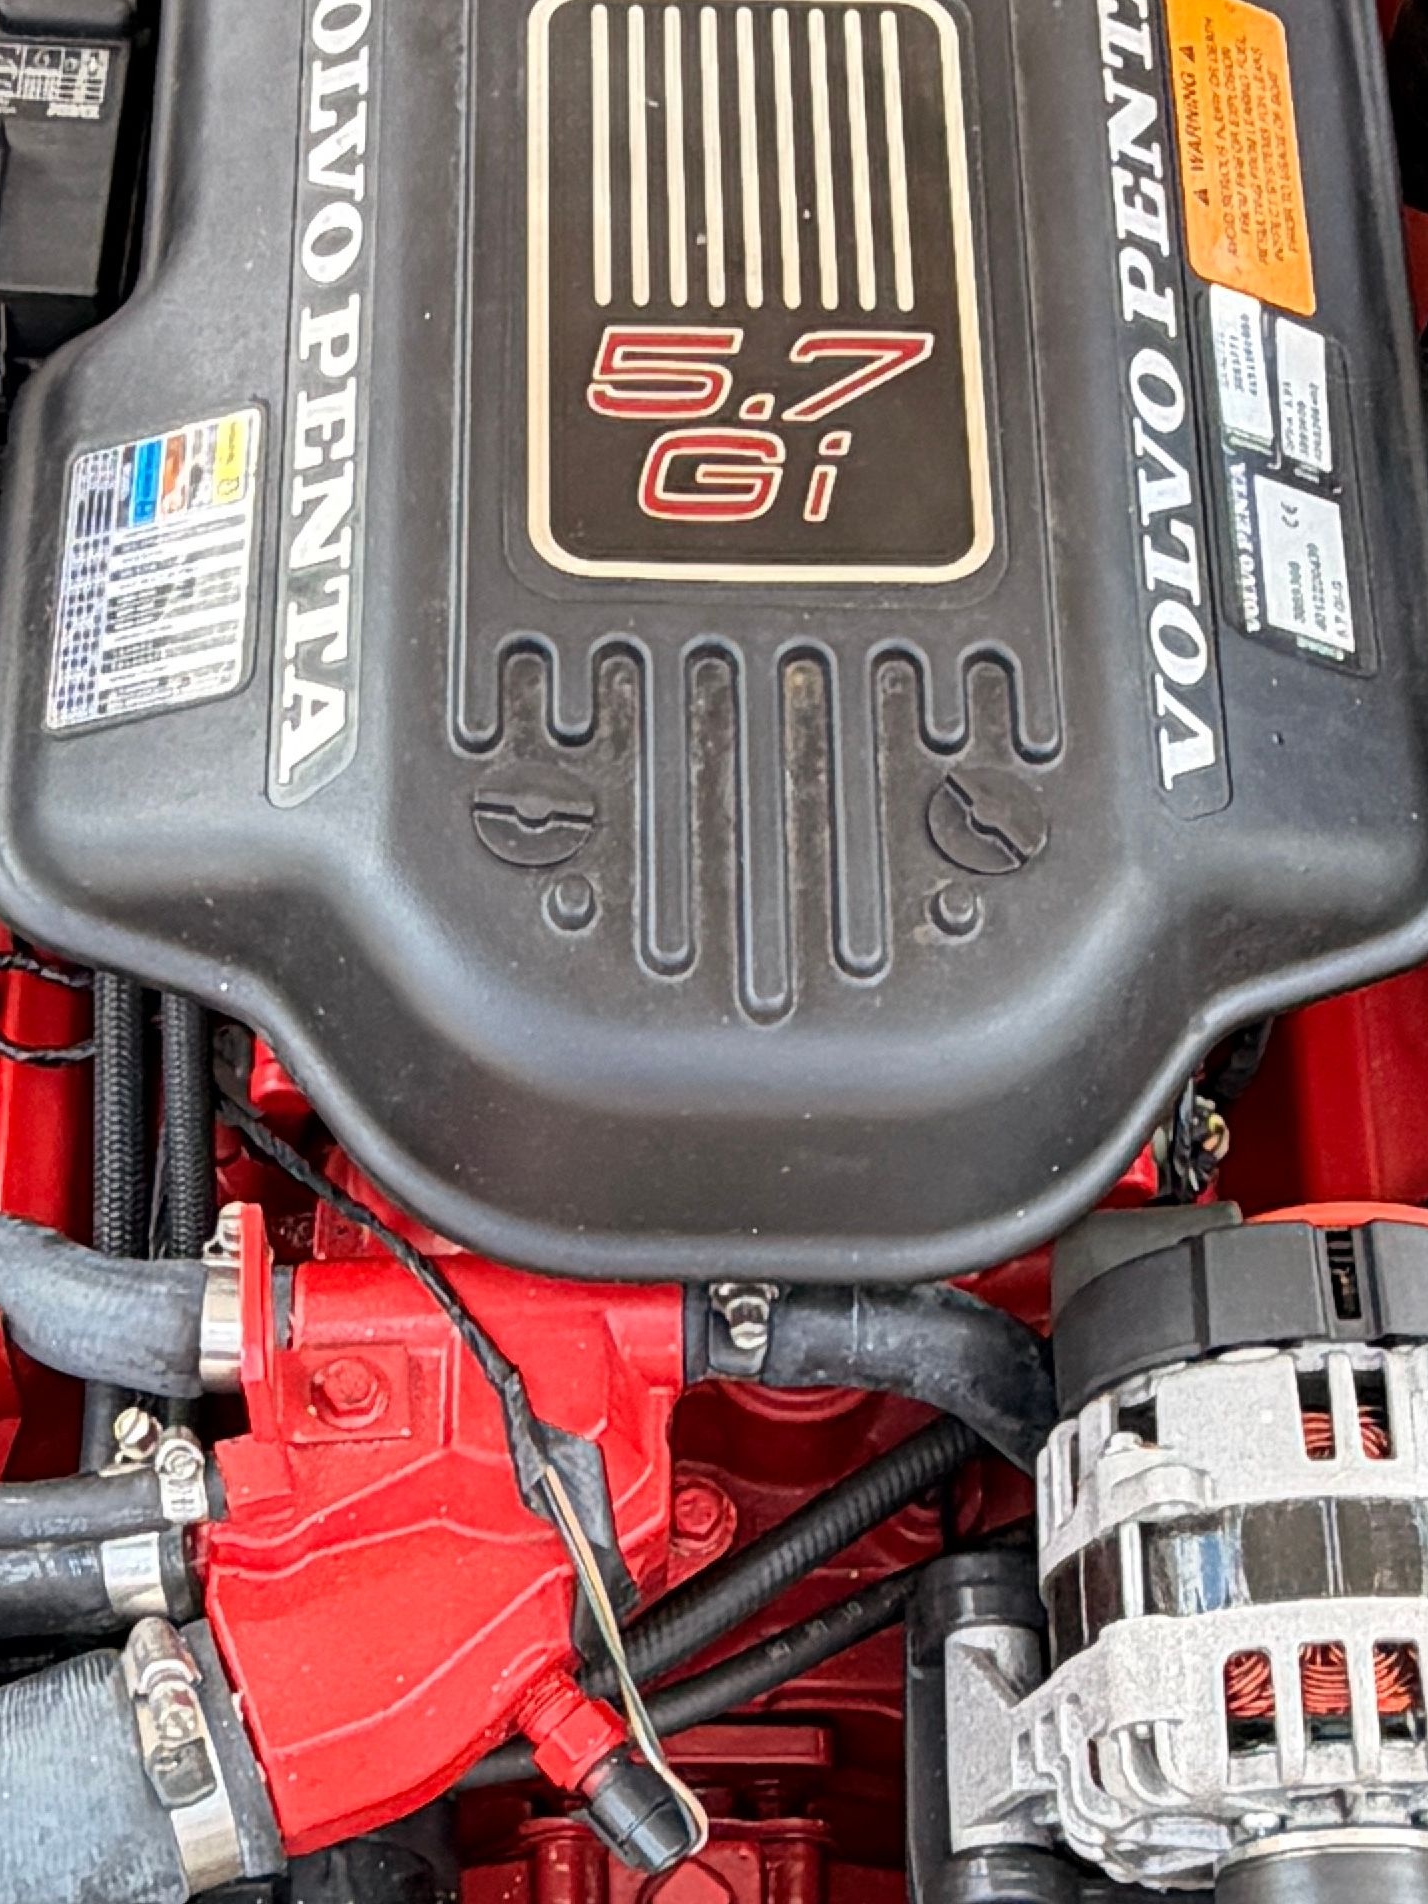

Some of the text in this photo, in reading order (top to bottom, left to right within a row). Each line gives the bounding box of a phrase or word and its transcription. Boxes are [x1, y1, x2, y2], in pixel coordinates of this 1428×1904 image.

[1179, 71, 1204, 173] WARNING
[586, 325, 935, 421] 5.7
[276, 292, 363, 786] PENTA
[637, 427, 852, 522] Gi
[1128, 347, 1218, 791] VOLVO
[1229, 461, 1262, 633] VOLVO PENTA
